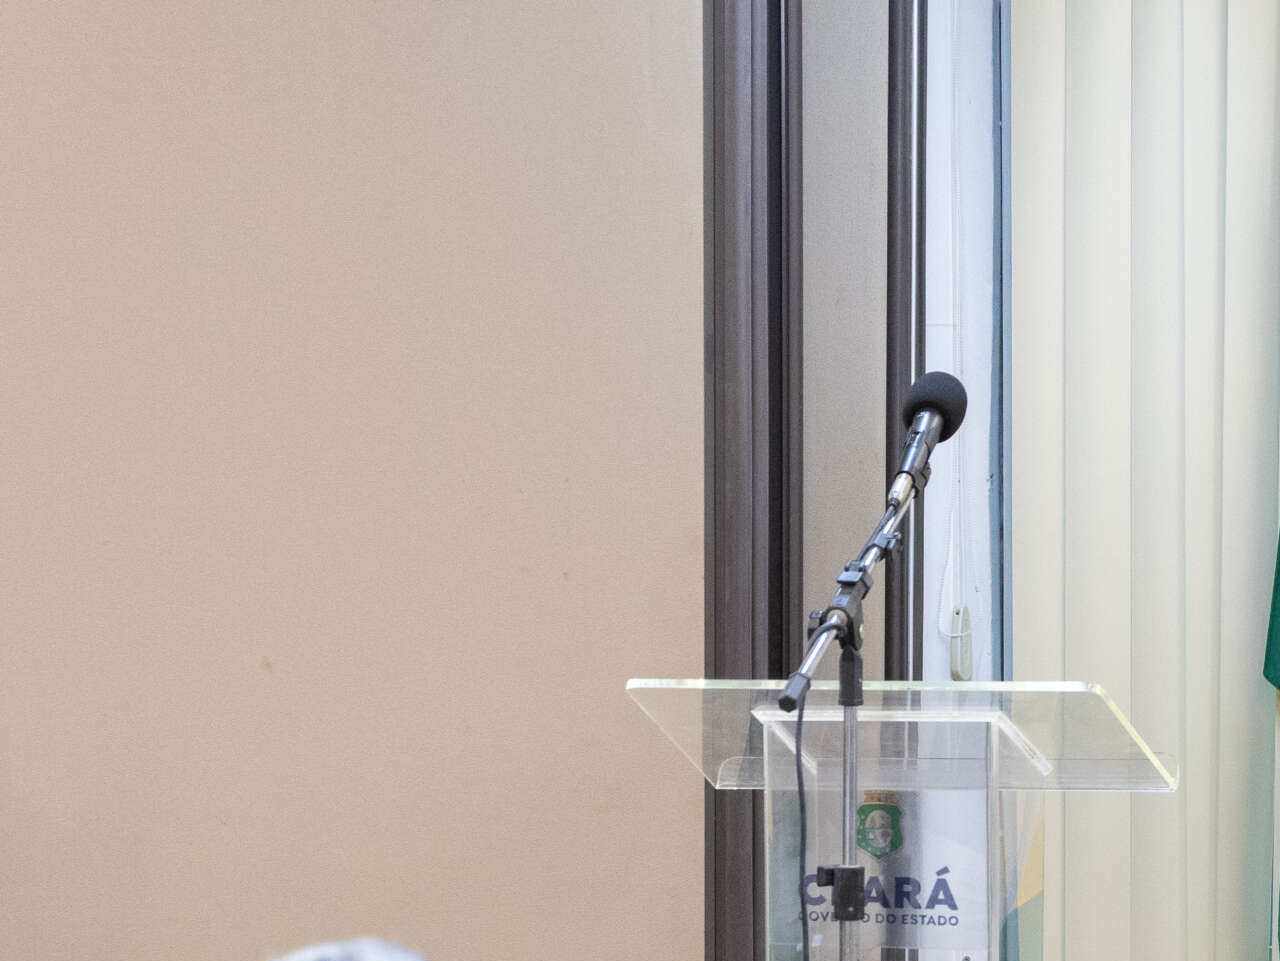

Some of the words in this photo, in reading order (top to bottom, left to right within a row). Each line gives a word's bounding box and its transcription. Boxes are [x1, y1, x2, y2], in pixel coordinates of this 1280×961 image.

[799, 866, 959, 911] CARÁ
[875, 913, 897, 925] DO
[901, 913, 960, 927] ESTADO
